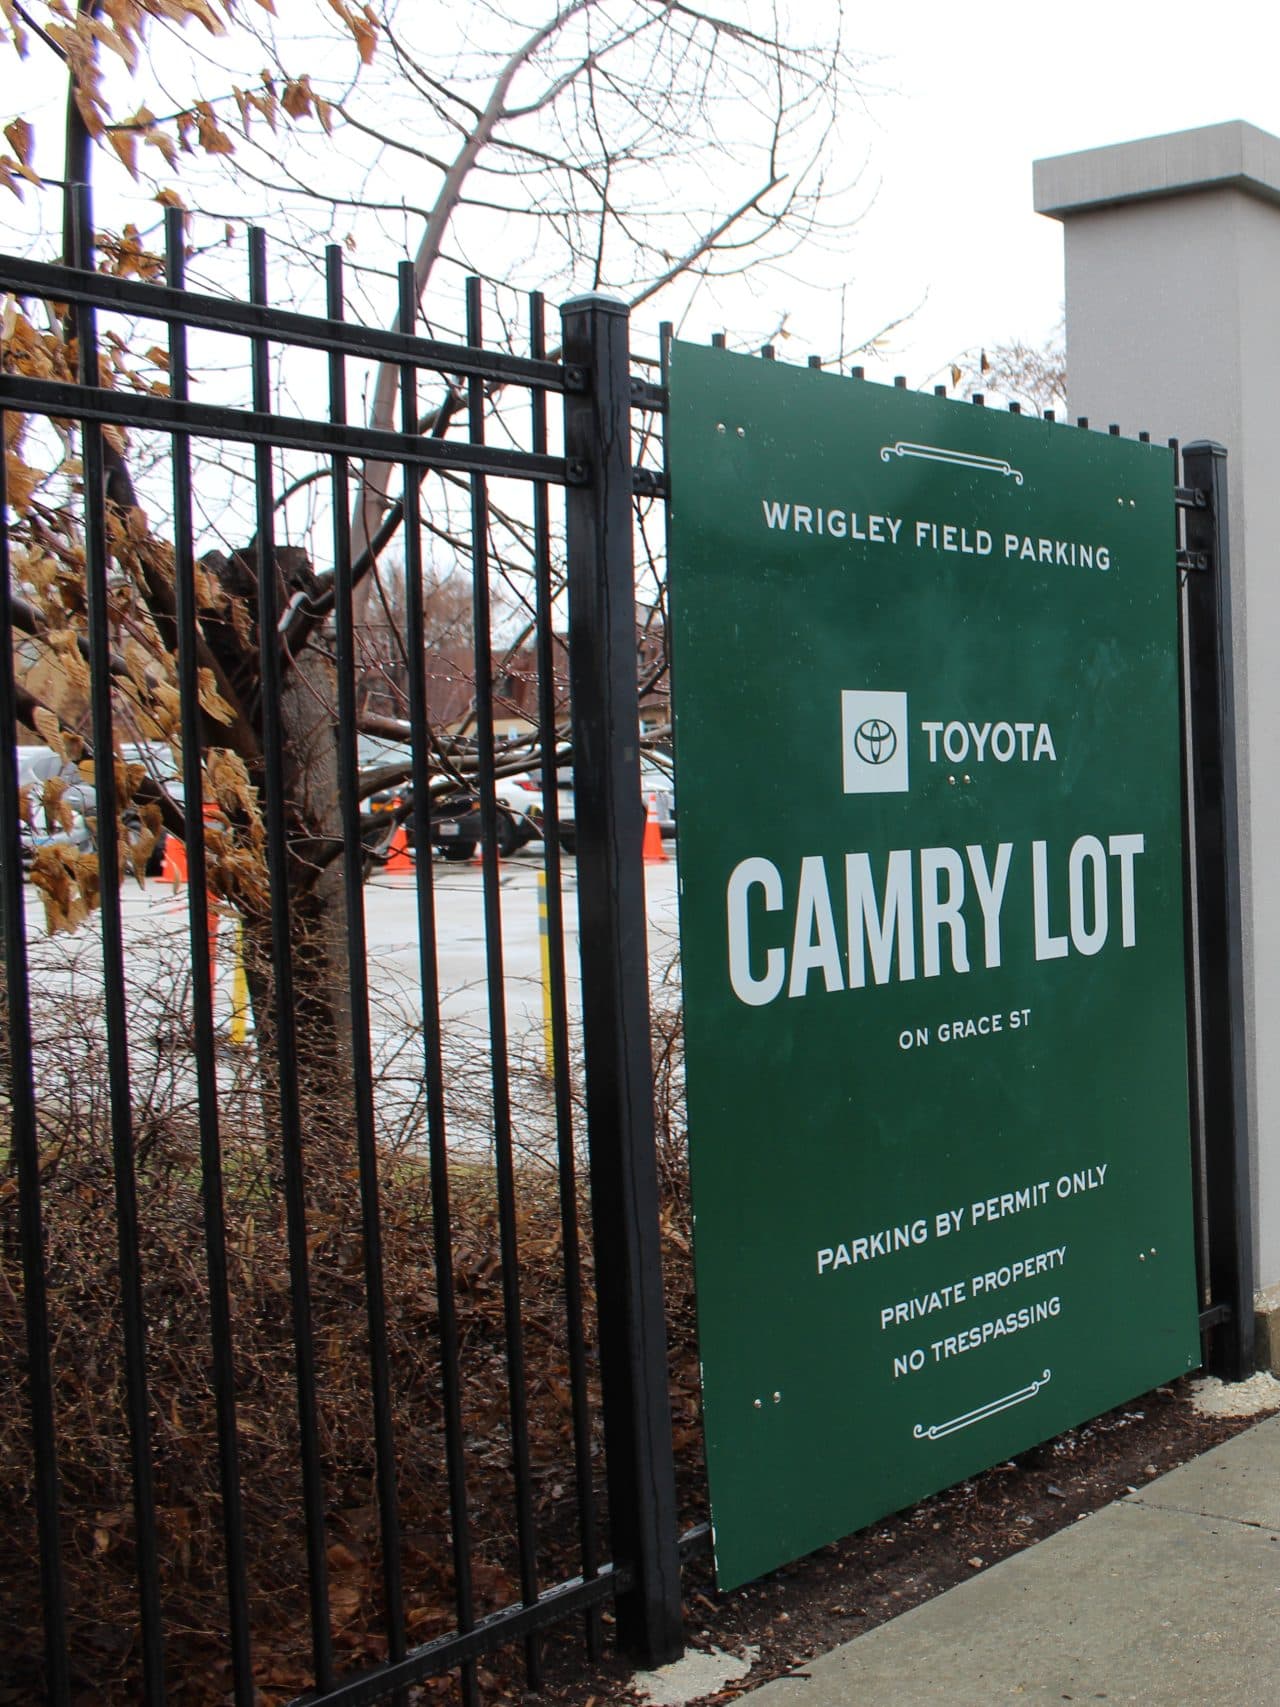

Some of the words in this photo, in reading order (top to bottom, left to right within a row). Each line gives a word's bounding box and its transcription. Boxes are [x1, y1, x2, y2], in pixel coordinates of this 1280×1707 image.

[762, 500, 902, 544] WRIGLEY
[915, 521, 993, 555] FIELD
[1004, 533, 1110, 571] PARKING
[921, 720, 1057, 763] TOYOTA
[726, 842, 1014, 1006] CAMRY
[1032, 833, 1145, 961] LOT
[898, 1027, 929, 1050] ON
[937, 1014, 1003, 1042] GRACE
[1009, 1008, 1031, 1029] ST
[817, 1219, 928, 1275] PARKING
[935, 1207, 964, 1238] BY
[971, 1181, 1050, 1226] PERMIT
[1056, 1163, 1108, 1198] ONLY
[880, 1282, 966, 1330] PRIVATE
[972, 1246, 1067, 1297] PROPERTY
[893, 1349, 925, 1378] NO
[930, 1296, 1061, 1362] TRESPASSING
